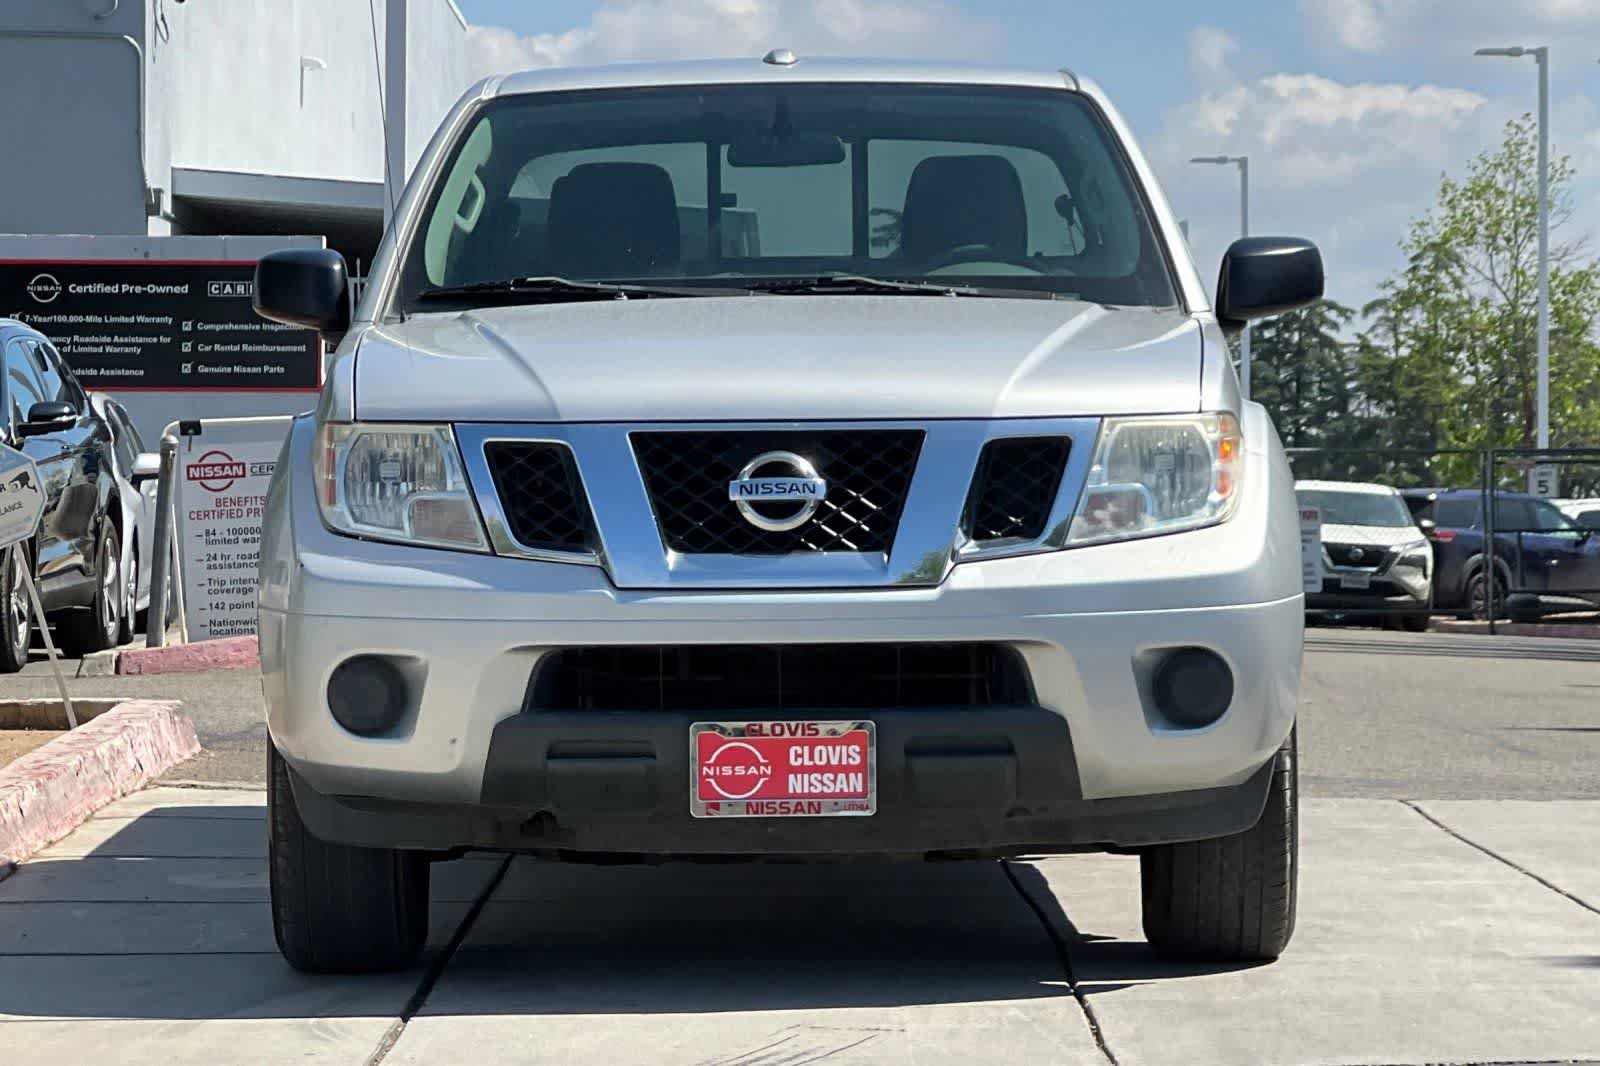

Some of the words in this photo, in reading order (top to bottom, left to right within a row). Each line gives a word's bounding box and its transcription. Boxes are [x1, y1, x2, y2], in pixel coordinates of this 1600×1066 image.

[68, 282, 119, 294] Certified
[121, 282, 189, 294] Pre-Owned
[209, 282, 252, 295] CAR
[104, 314, 134, 323] Limited
[136, 315, 173, 325] Warranty
[197, 322, 261, 332] Comprehensive
[73, 335, 112, 343] Roadside
[113, 335, 158, 344] Assistance
[160, 335, 172, 343] for
[62, 345, 71, 353] of
[72, 345, 103, 353] Limited
[105, 346, 142, 355] Warranty
[197, 343, 212, 353] Car
[213, 343, 240, 353] Rental
[241, 343, 306, 353] Reimbursement
[99, 368, 144, 376] Assistance
[197, 365, 232, 374] Genuine
[233, 364, 262, 374] Nissan
[263, 364, 285, 374] Parts
[188, 464, 243, 478] NISSAN
[739, 482, 816, 495] NISSAN
[1537, 479, 1549, 494] 5
[215, 495, 267, 508] BENEFITS
[188, 508, 244, 521] CERTIFIED
[205, 528, 217, 537] 84
[226, 526, 262, 537] 100000
[205, 537, 239, 546] limited
[206, 553, 218, 562] 24
[220, 552, 233, 561] hr.
[236, 551, 260, 561] road
[208, 577, 227, 588] Trip
[207, 586, 254, 596] coverage
[209, 602, 226, 611] 142
[229, 600, 255, 611] point
[209, 627, 256, 637] locations
[745, 722, 820, 737] CLOVIS
[788, 744, 861, 767] CLOVIS
[702, 765, 771, 777] NISSAN
[787, 772, 863, 794] NISSAN
[745, 801, 822, 815] NISSAN
